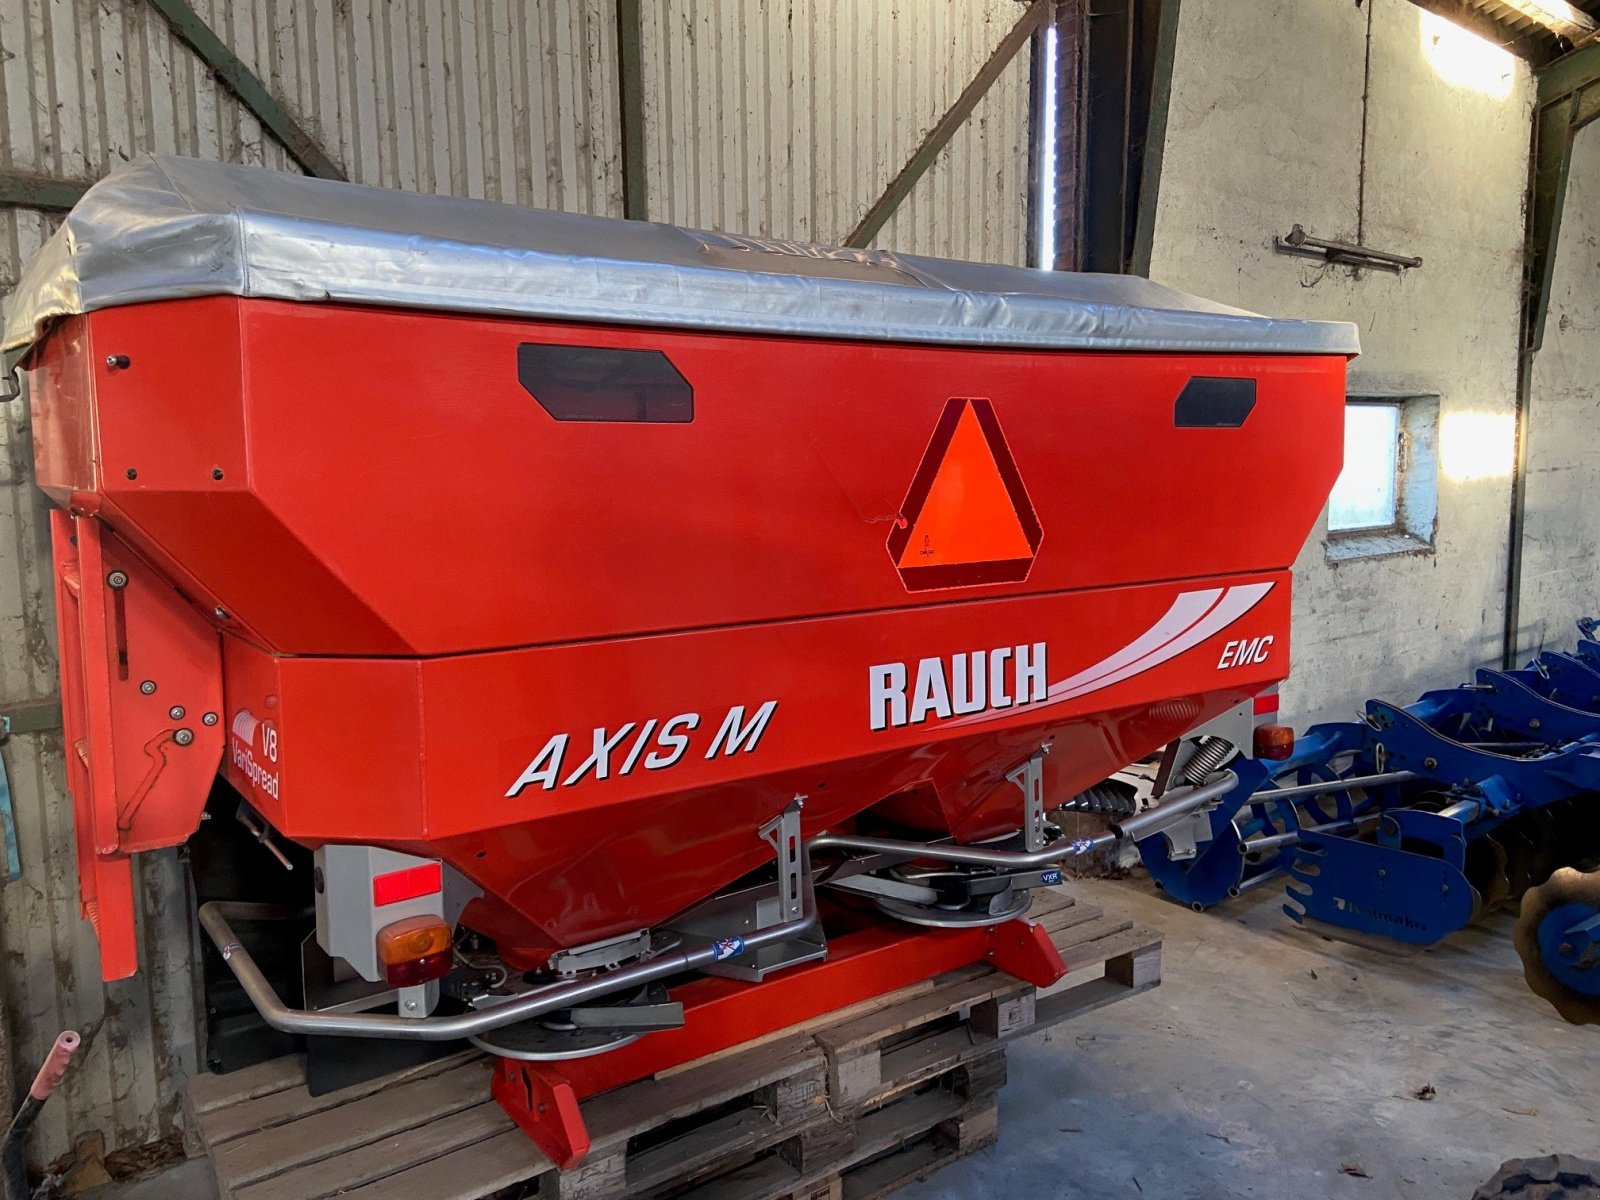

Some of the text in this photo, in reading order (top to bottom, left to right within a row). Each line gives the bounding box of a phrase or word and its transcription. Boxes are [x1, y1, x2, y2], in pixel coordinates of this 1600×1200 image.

[1217, 635, 1274, 670] EMC
[869, 642, 1048, 731] RAUCH
[232, 736, 279, 801] VariSpread
[262, 723, 278, 763] V8
[504, 700, 778, 798] AXIS M
